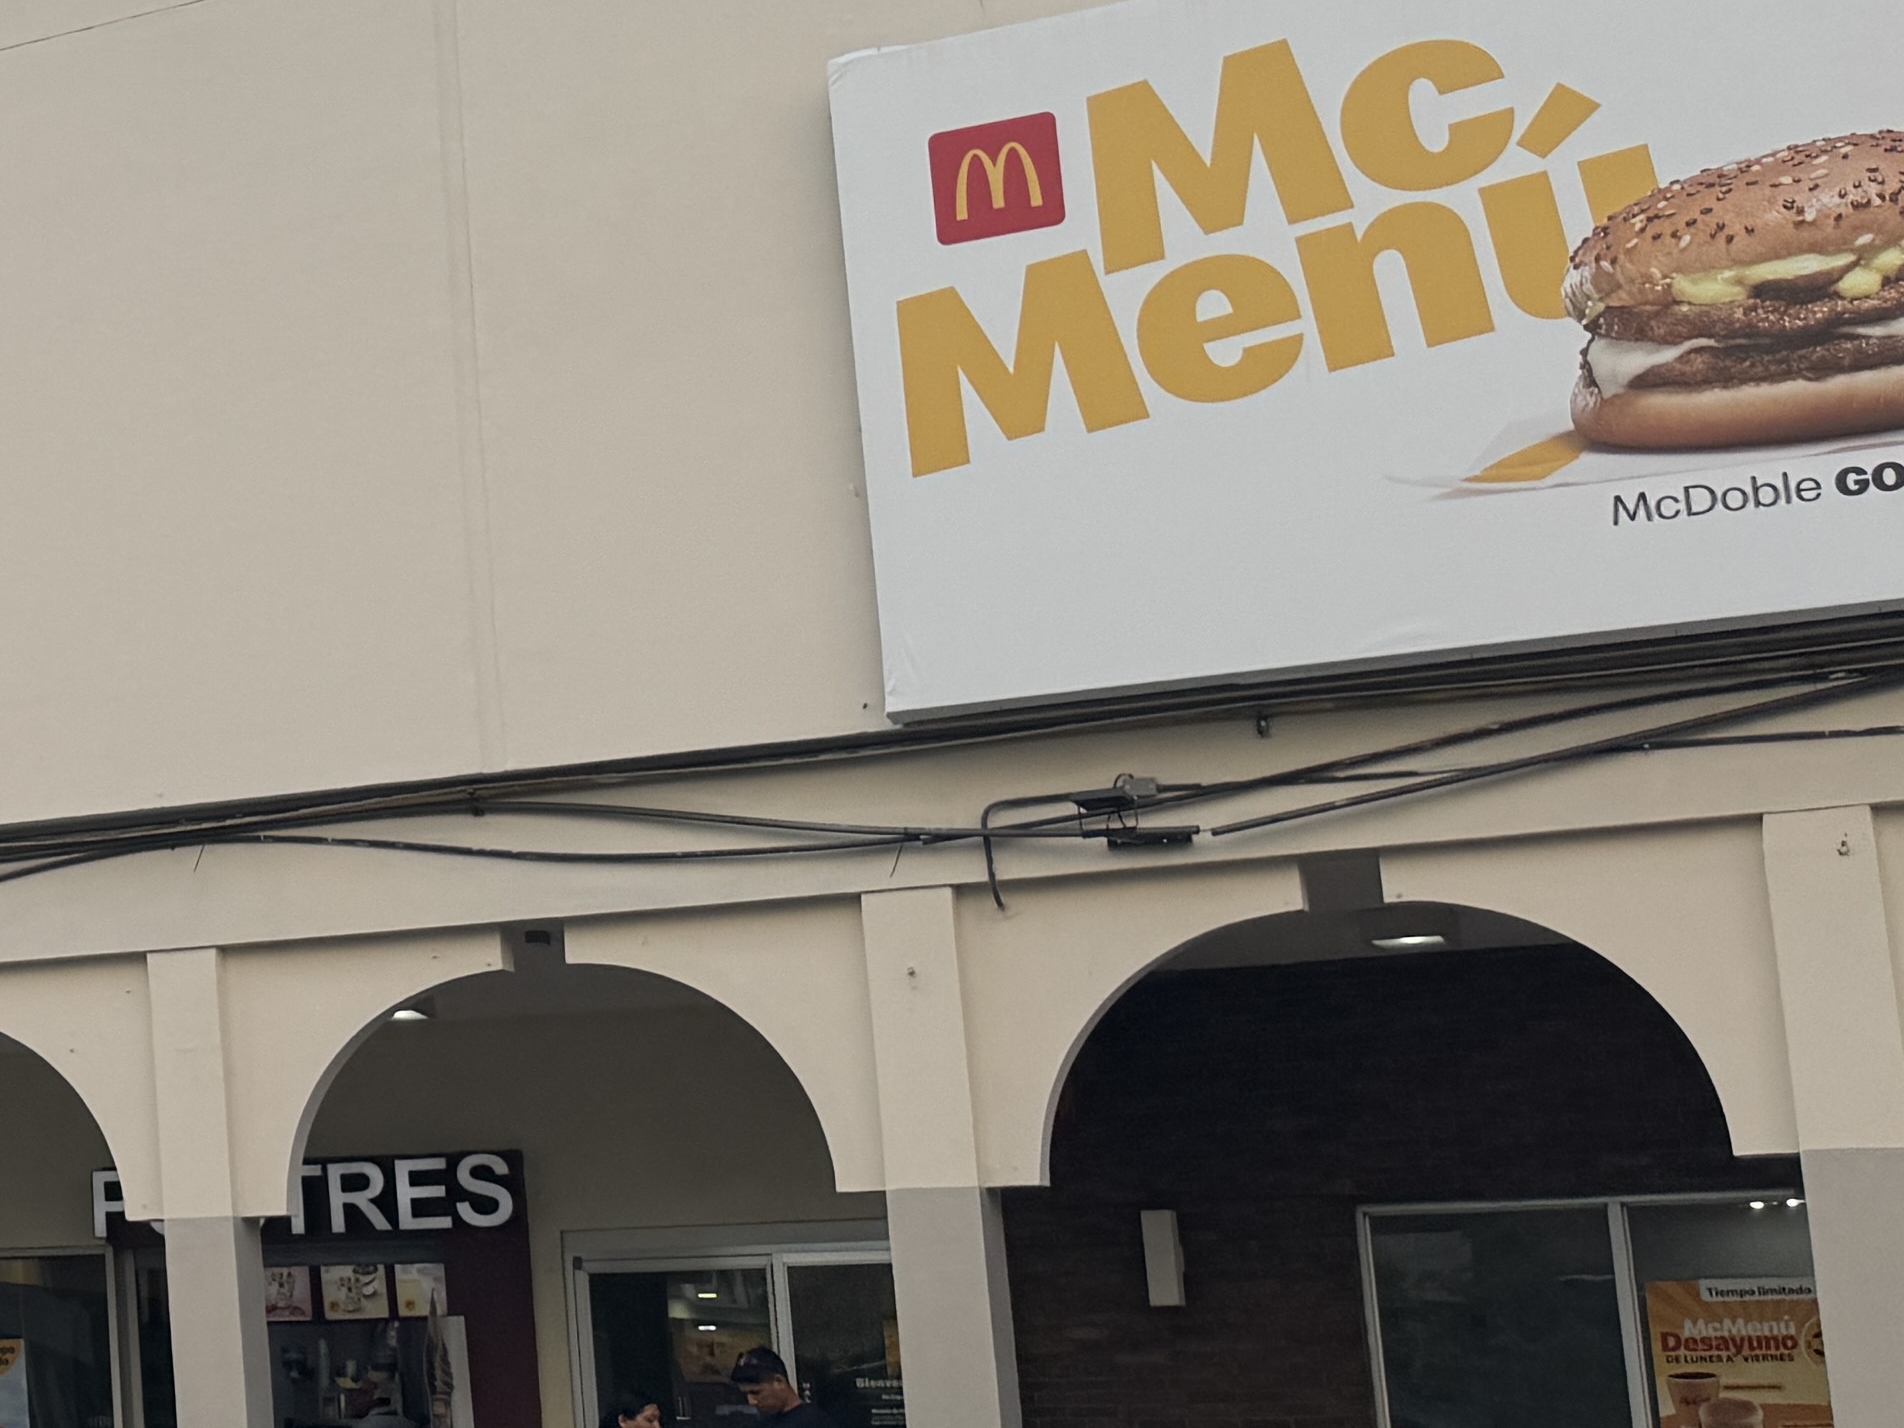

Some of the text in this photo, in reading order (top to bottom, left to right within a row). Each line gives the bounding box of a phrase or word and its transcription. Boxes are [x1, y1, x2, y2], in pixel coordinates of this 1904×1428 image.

[1086, 38, 1516, 276] Mc
[896, 80, 1661, 478] Menú
[1612, 471, 1823, 526] McDoble
[92, 1153, 514, 1238] PTRES
[1707, 1286, 1755, 1299] Tiempo
[1660, 1331, 1799, 1358] Desayuno
